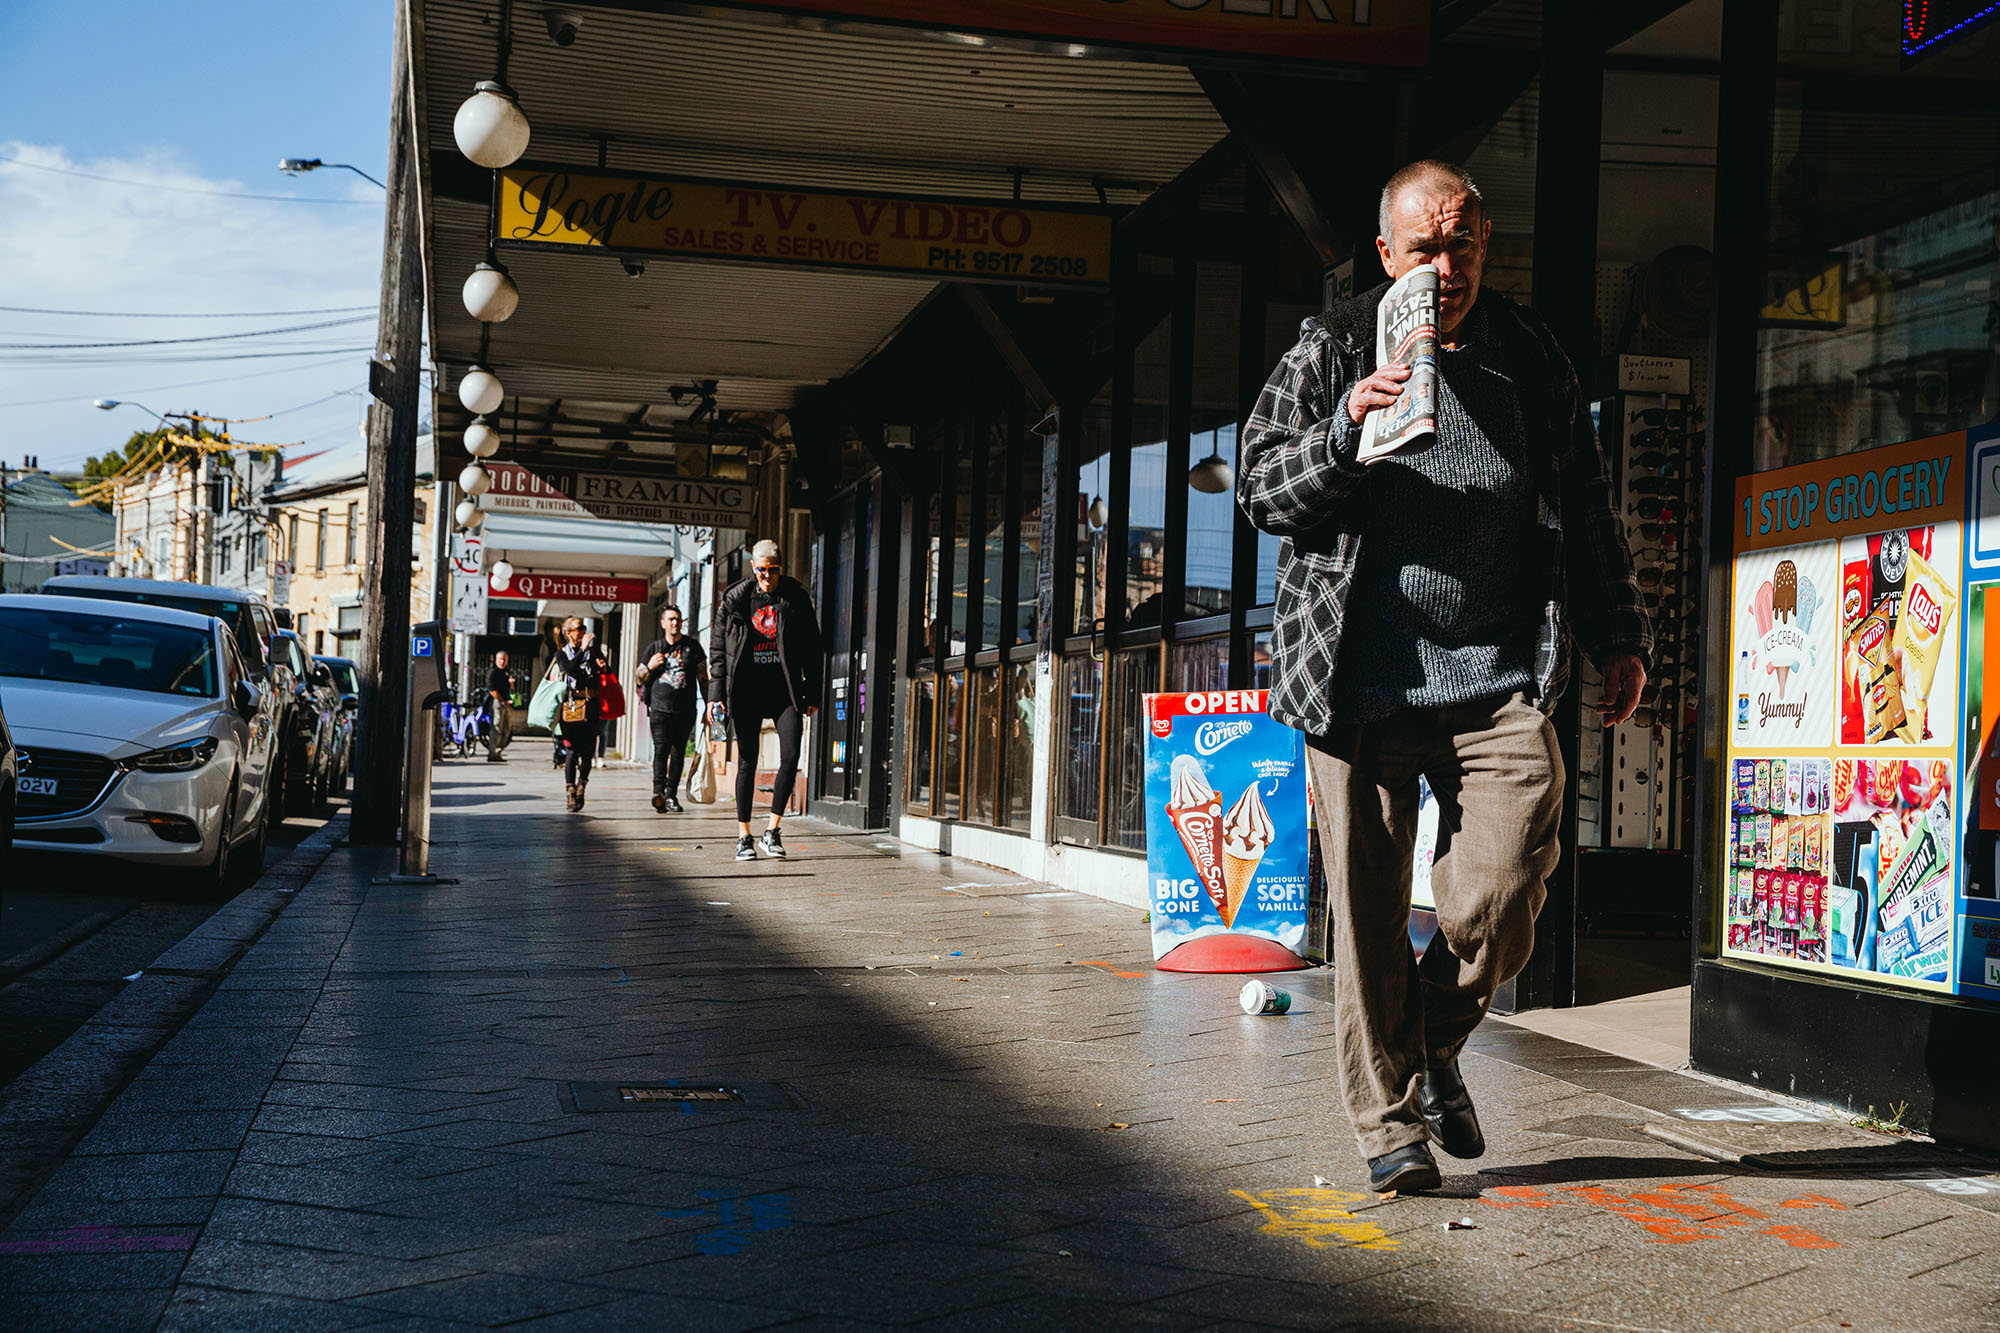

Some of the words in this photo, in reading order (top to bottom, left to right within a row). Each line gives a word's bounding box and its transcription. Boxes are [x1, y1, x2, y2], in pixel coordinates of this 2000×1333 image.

[512, 170, 674, 247] Logie
[848, 199, 1032, 248] VIDEO
[663, 227, 745, 256] SALES
[750, 237, 769, 257] &
[776, 237, 882, 263] SERVICE
[927, 245, 968, 271] PH:
[972, 249, 1022, 274] 9517
[1029, 254, 1087, 278] 2508
[1391, 308, 1436, 350] HINK
[583, 477, 743, 508] FRAMING
[1743, 496, 1752, 538] 1
[1759, 482, 1821, 535] STOP
[1824, 456, 1952, 524] GROCERY
[519, 576, 533, 597] Q
[540, 577, 619, 599] Printing
[417, 640, 429, 654] P
[1184, 692, 1260, 715] OPEN
[1757, 691, 1808, 729] Yummy!
[1194, 719, 1253, 756] Cornetto
[1178, 811, 1215, 872] Cornetto
[1202, 864, 1225, 900] Soft
[1155, 878, 1200, 900] BIG
[1256, 876, 1306, 885] DELICIOUSLY
[1256, 883, 1307, 902] SOFT
[1155, 901, 1201, 914] CONE
[1257, 902, 1308, 913] VANILLA
[1911, 888, 1940, 911] Extra
[1920, 898, 1943, 929] ICE
[1890, 944, 1950, 978] Airwav
